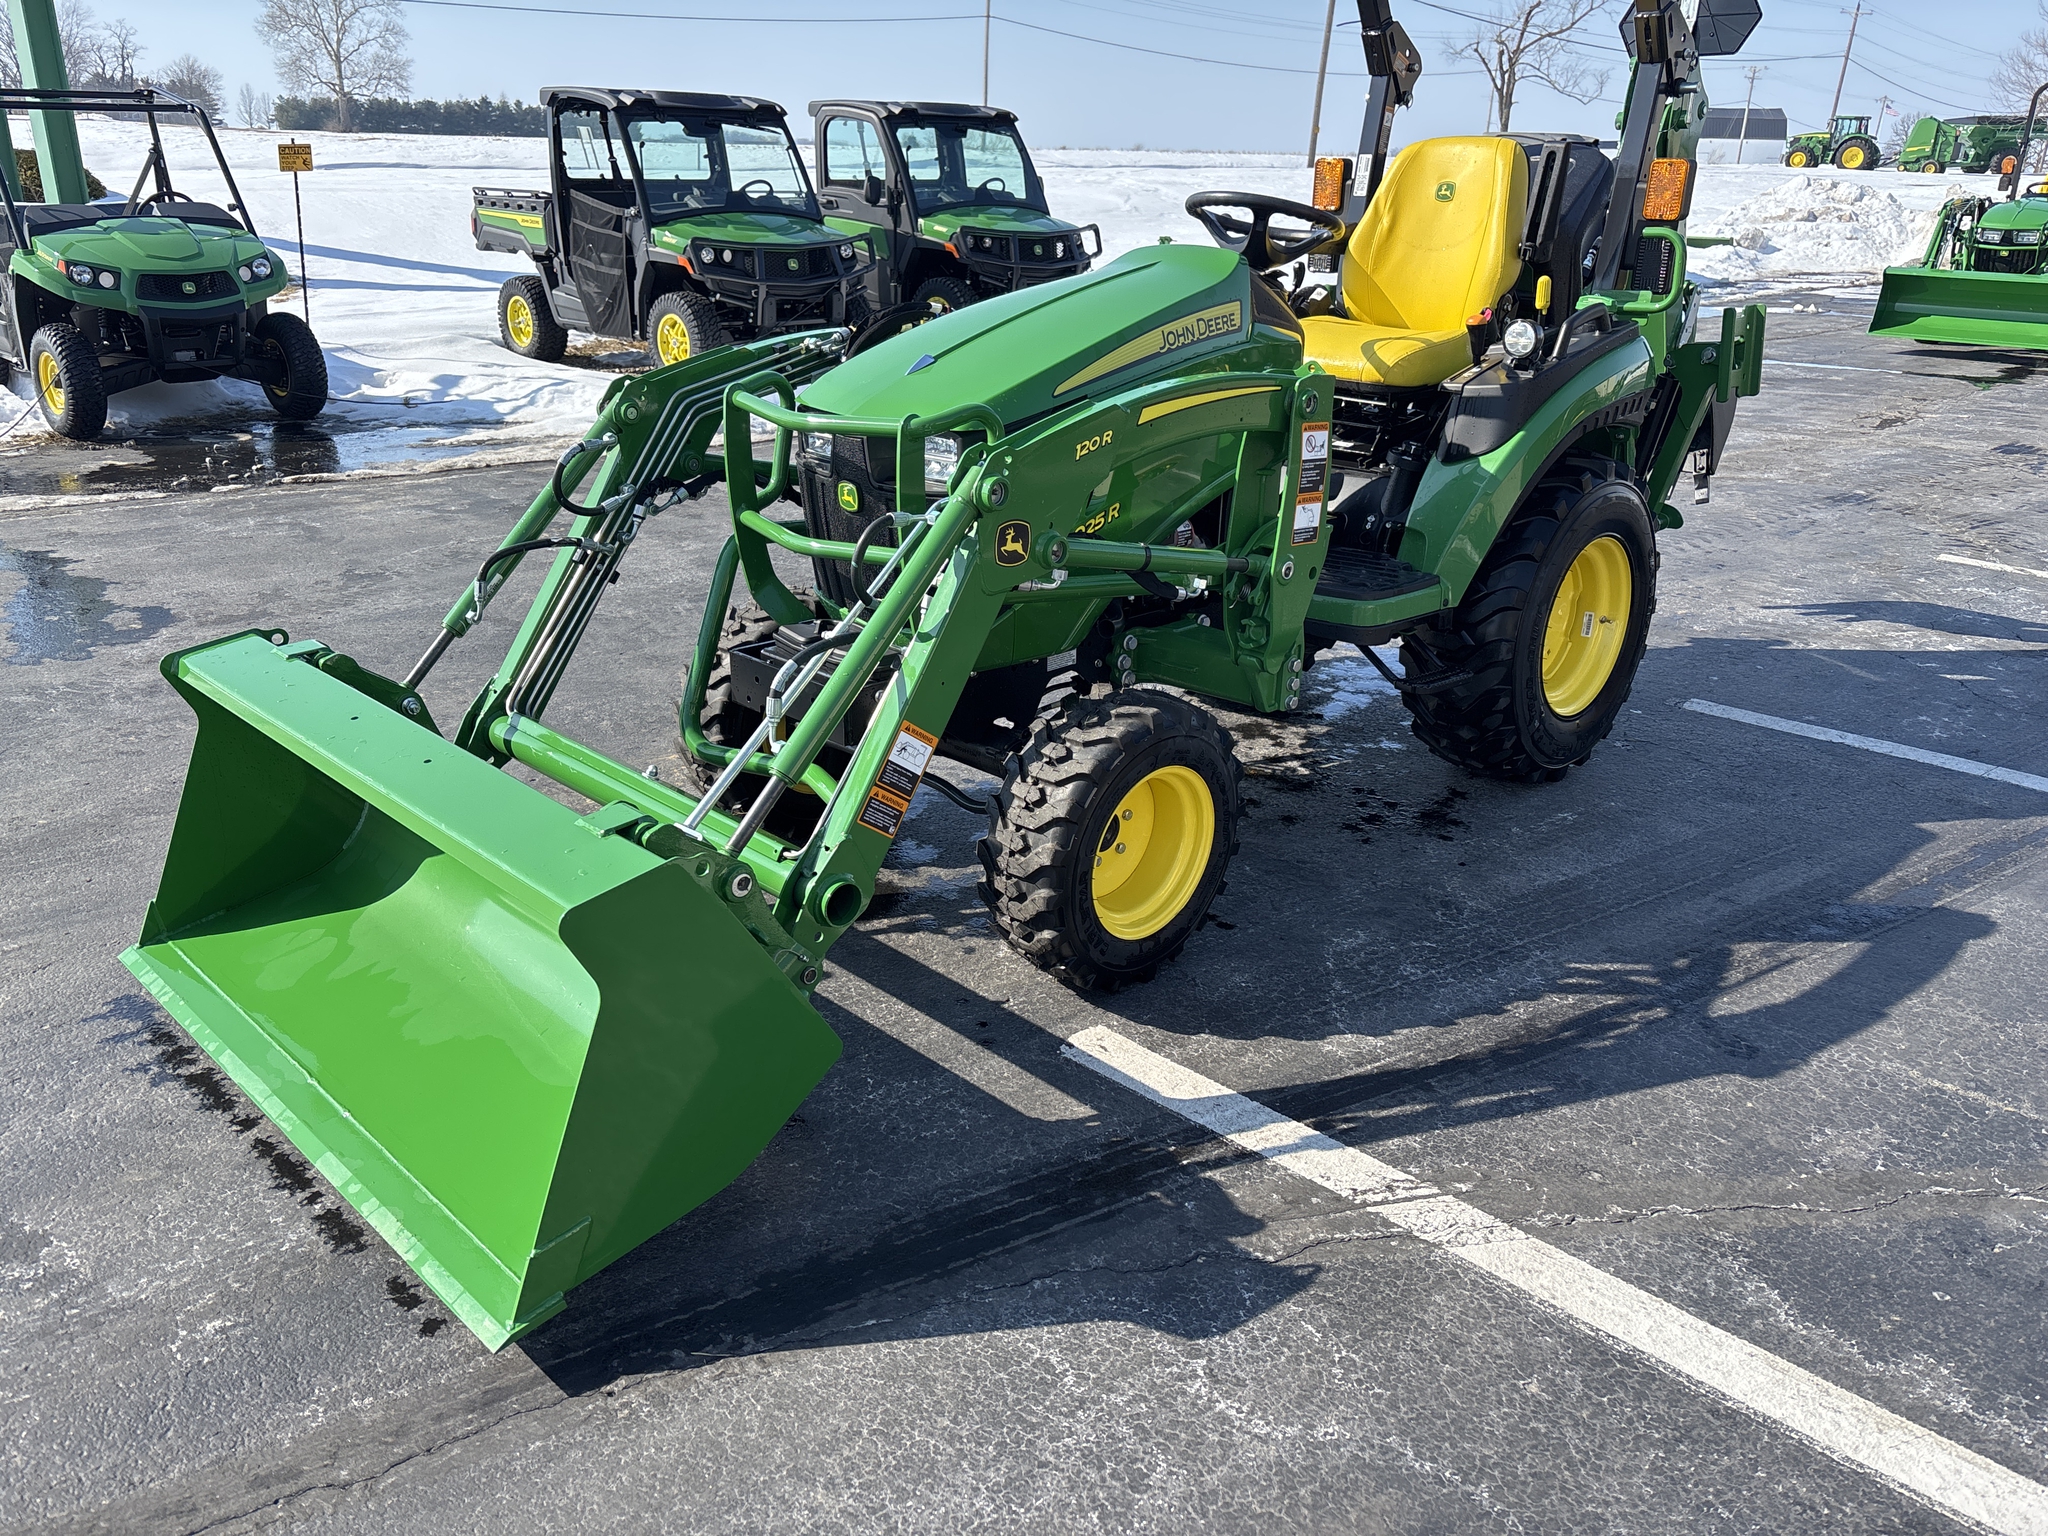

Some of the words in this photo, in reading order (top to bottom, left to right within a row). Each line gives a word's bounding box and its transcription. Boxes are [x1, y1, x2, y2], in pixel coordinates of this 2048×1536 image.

[1159, 324, 1195, 350] JOHN
[1196, 313, 1236, 336] DEERE
[1307, 423, 1328, 431] WARNING
[1075, 436, 1100, 461] 120
[1102, 430, 1113, 447] R
[1107, 502, 1120, 523] R
[911, 727, 934, 744] WARNING
[880, 794, 904, 810] WARNING
